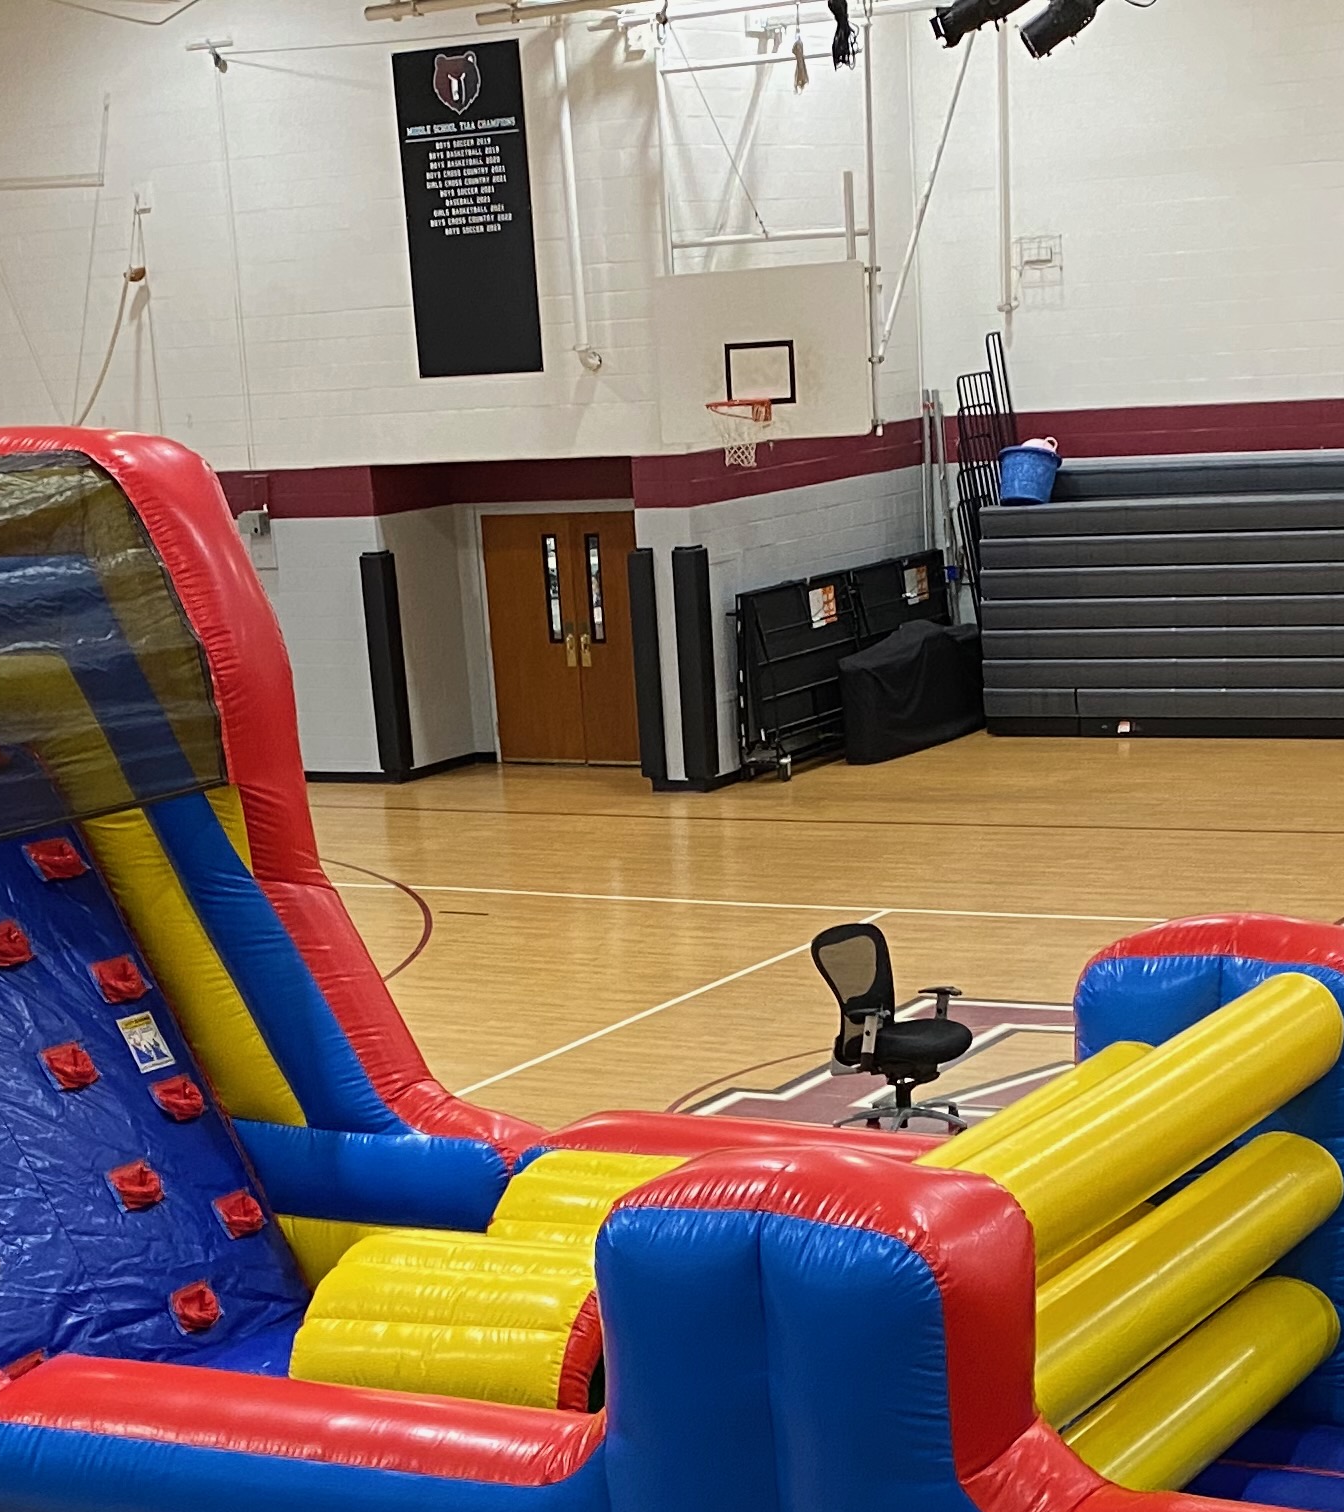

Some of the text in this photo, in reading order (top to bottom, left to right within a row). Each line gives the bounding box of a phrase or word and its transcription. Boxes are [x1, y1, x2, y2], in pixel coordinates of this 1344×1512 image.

[406, 125, 431, 136] MIDDLE
[433, 122, 457, 134] SCHOOL
[477, 116, 516, 129] CHAMPIONS
[435, 140, 450, 150] BOYS
[453, 138, 474, 148] SOCCER
[429, 151, 444, 160] BOYS
[446, 148, 482, 159] BASKETBALL
[430, 161, 445, 170] BOYS
[447, 157, 483, 168] BASKETBALL
[426, 171, 441, 180] BOYS
[443, 169, 461, 178] CROSS
[463, 166, 488, 176] COUNTRY
[426, 180, 442, 189] GIRLS
[444, 178, 462, 188] CROSS
[464, 176, 490, 185] COUNTRY
[439, 188, 455, 198] BOYS
[457, 186, 478, 196] SOCCER
[445, 197, 474, 207] BASEBALL
[433, 208, 449, 217] GIRLS
[451, 206, 488, 216] BASKETBALL
[430, 218, 446, 227] BOYS
[447, 216, 466, 226] CROSS
[468, 214, 494, 224] COUNTRY
[445, 227, 460, 235] BOYS
[462, 225, 484, 234] SOCCER
